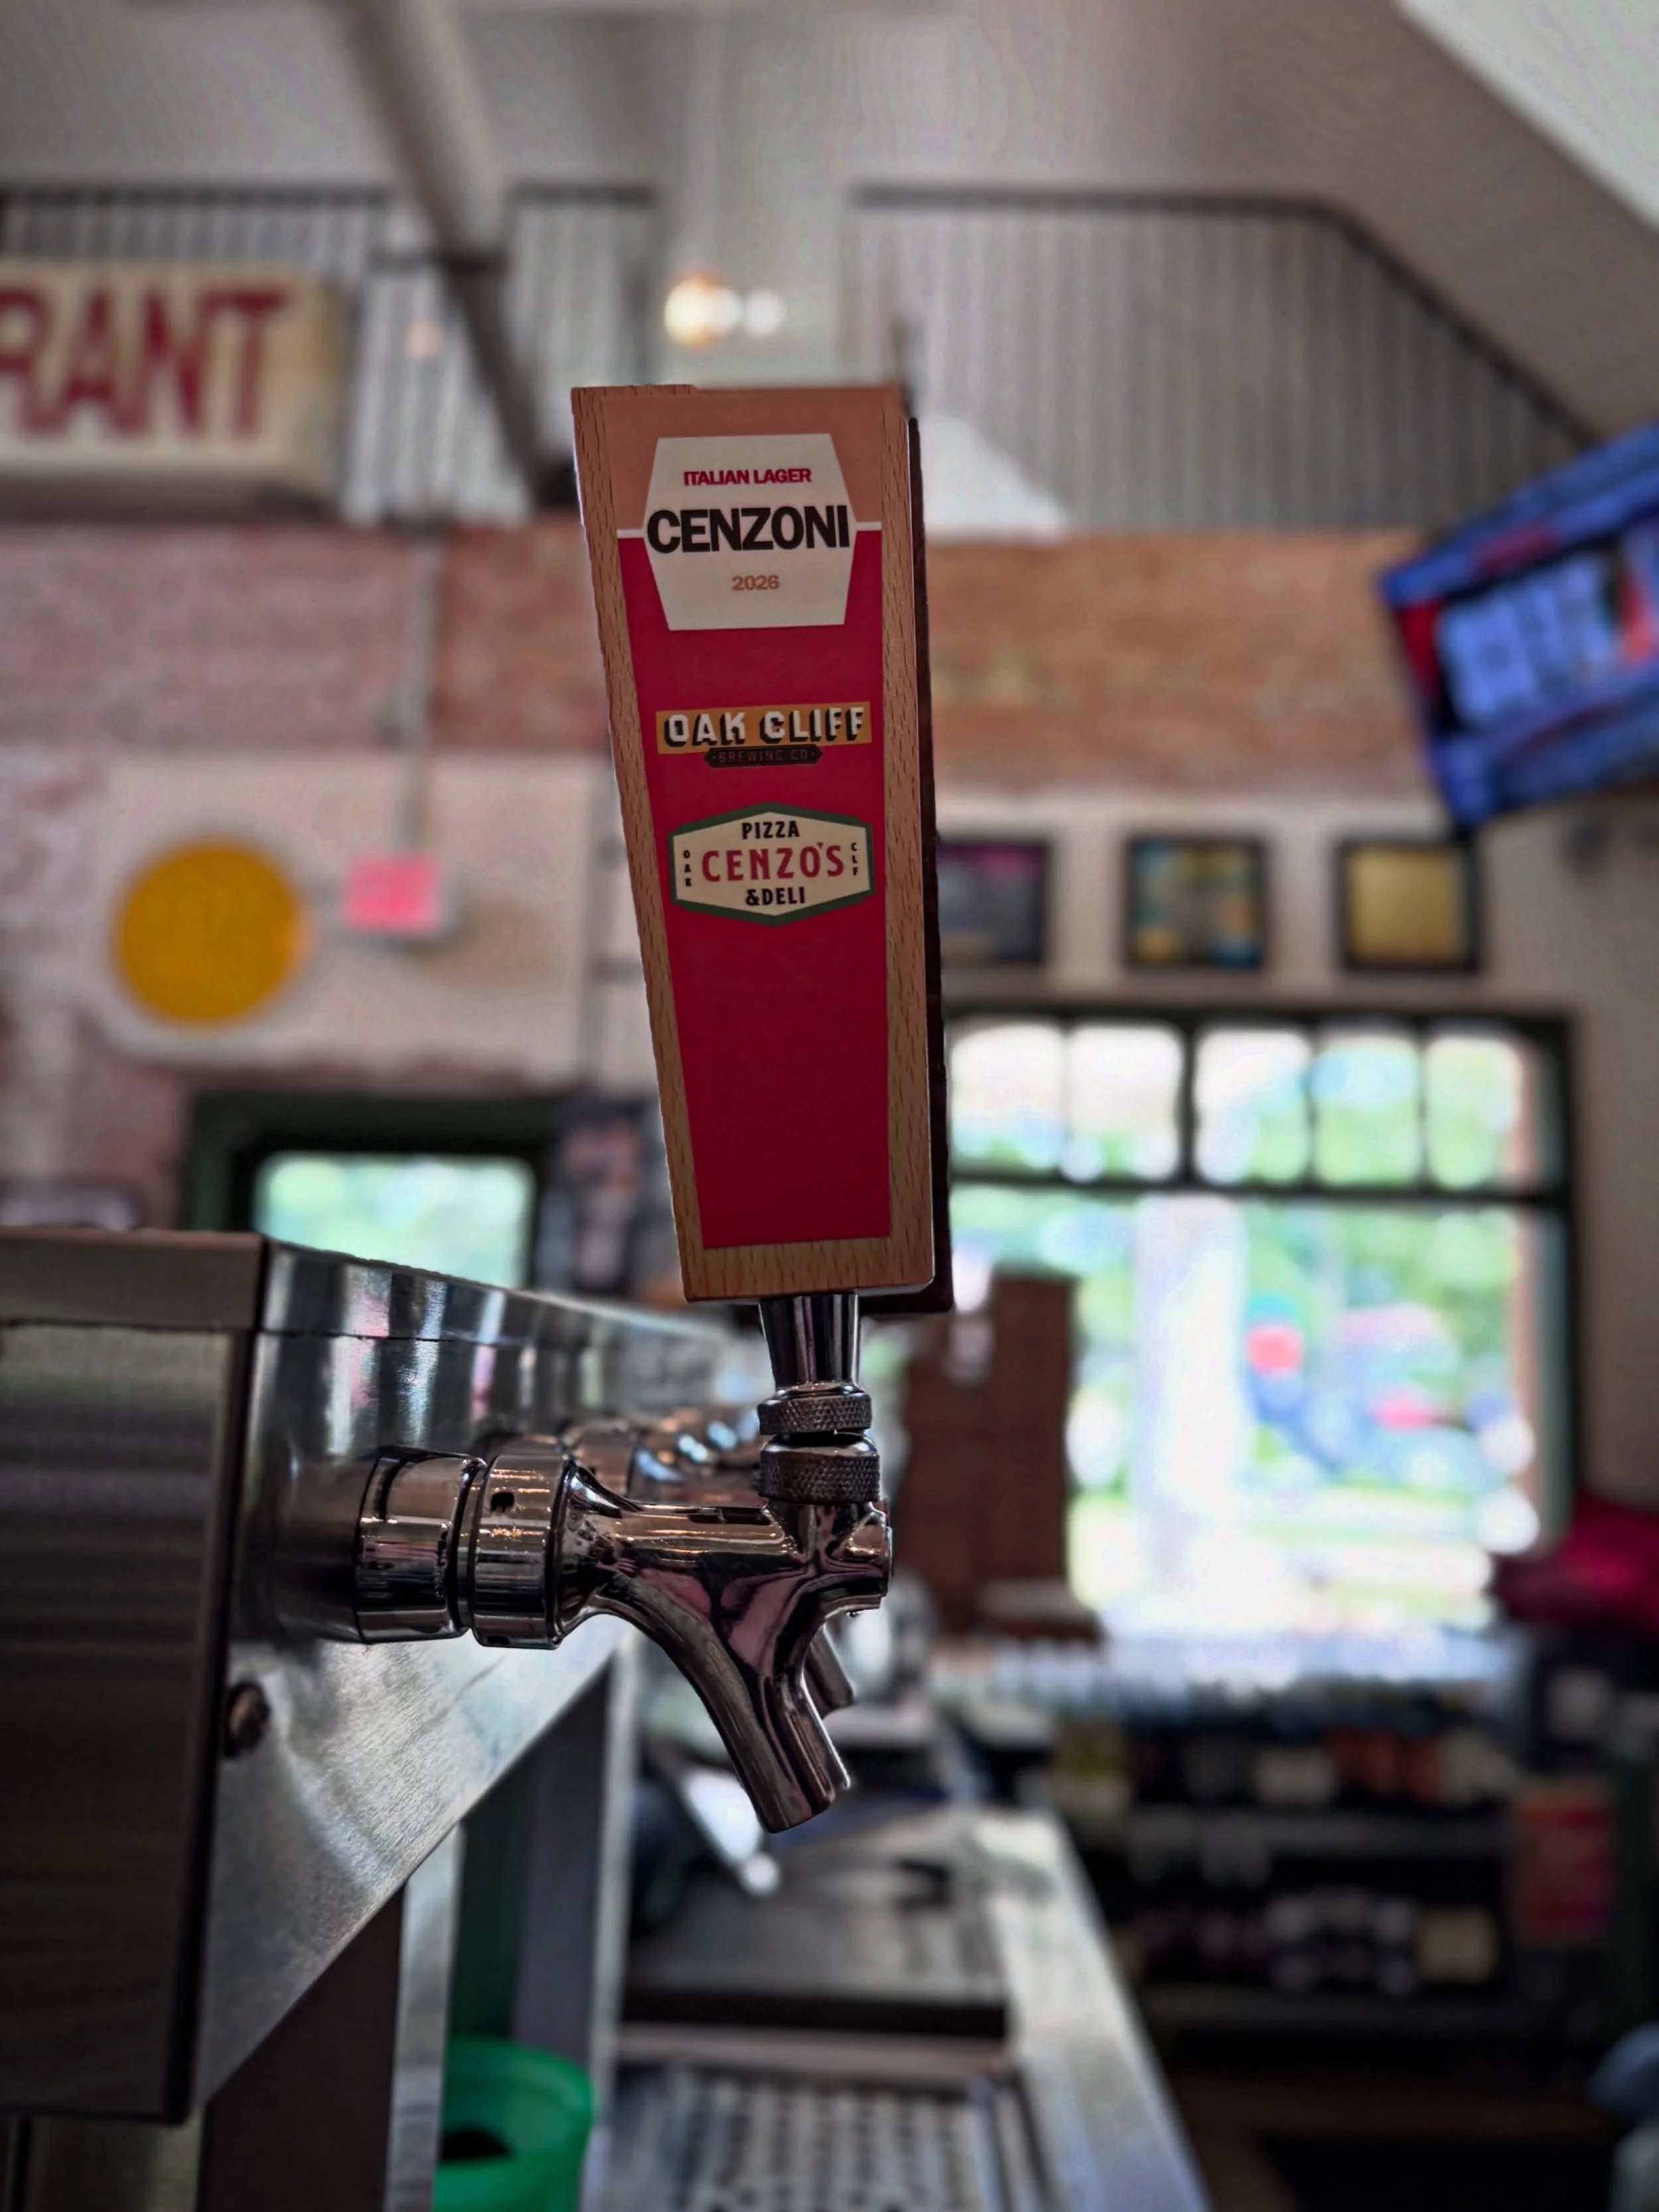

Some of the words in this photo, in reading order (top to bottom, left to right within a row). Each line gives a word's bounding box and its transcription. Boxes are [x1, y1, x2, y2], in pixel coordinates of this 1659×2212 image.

[684, 470, 749, 486] ITALIAN
[754, 468, 812, 484] LAGER
[646, 504, 850, 553] CENZONI
[731, 575, 780, 591] 2026
[665, 711, 746, 747] OAK
[759, 707, 864, 744] CLIFF
[718, 749, 783, 764] BREWING
[742, 820, 800, 840] PIZZA
[701, 842, 845, 883] CENZO'S
